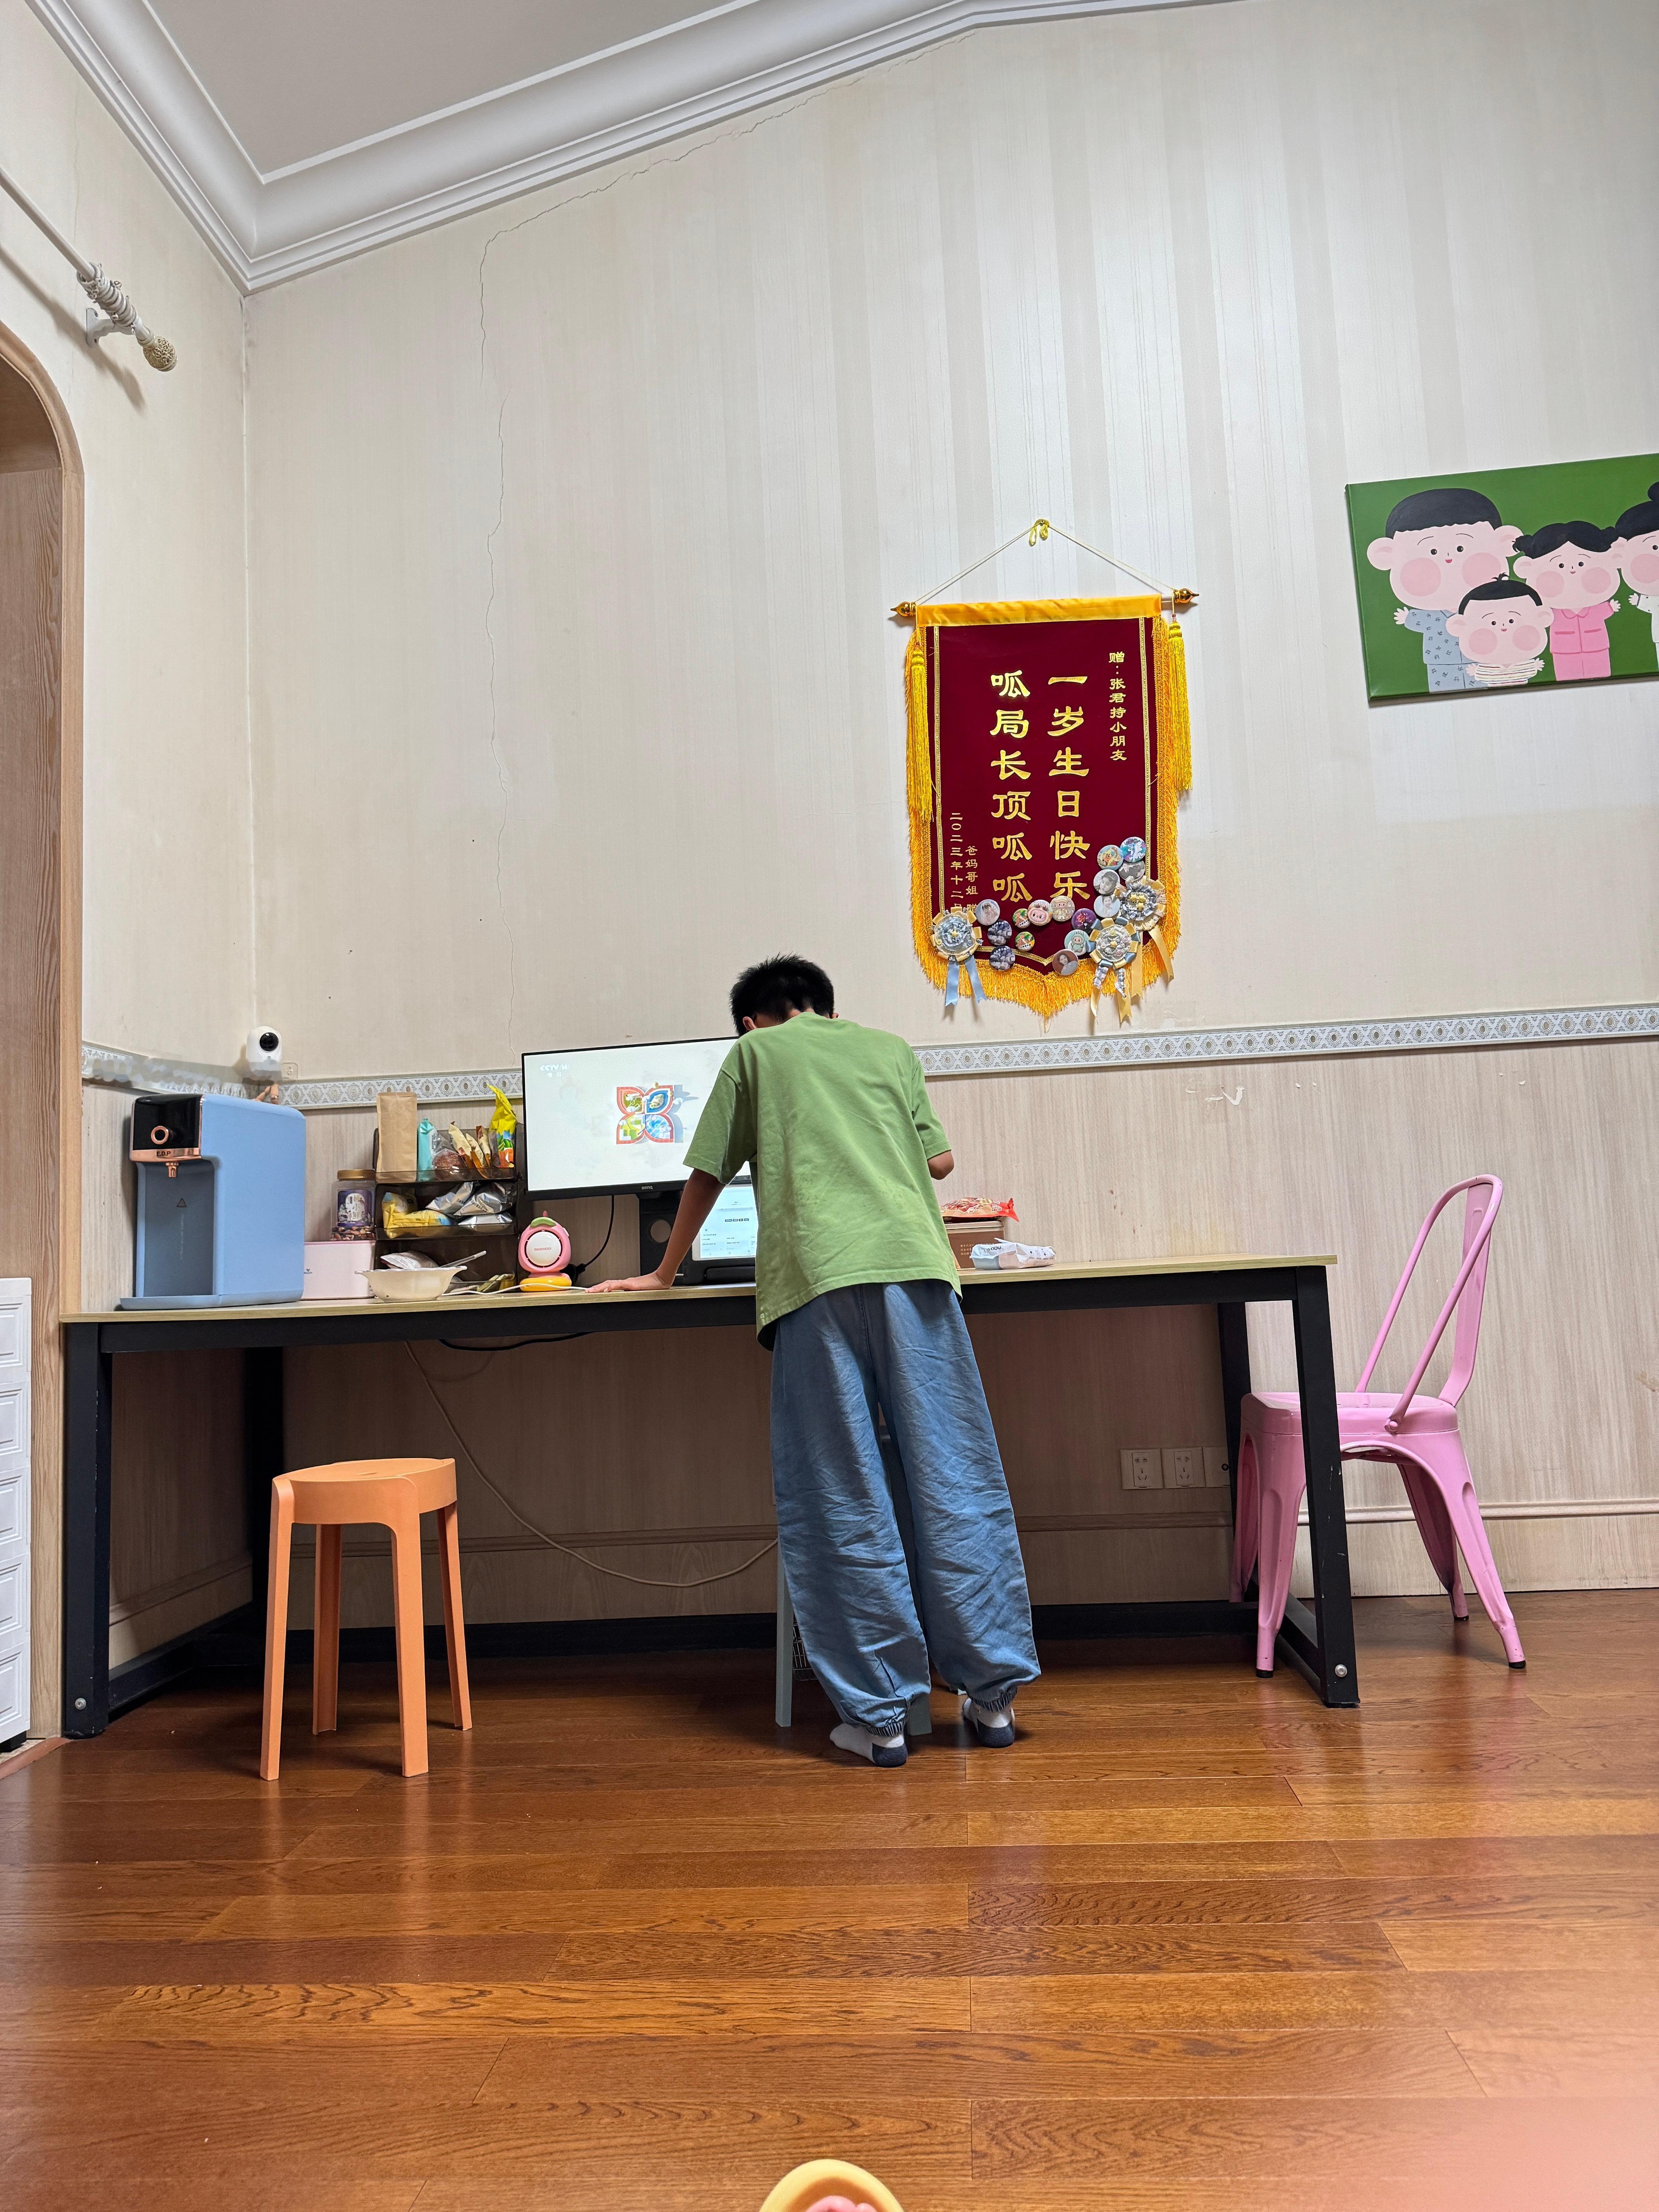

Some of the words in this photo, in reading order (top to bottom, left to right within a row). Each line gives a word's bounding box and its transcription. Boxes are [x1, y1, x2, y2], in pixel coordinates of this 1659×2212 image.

[989, 670, 1033, 903] 呱局长顶呱呱
[1047, 676, 1091, 900] 一岁生日快乐
